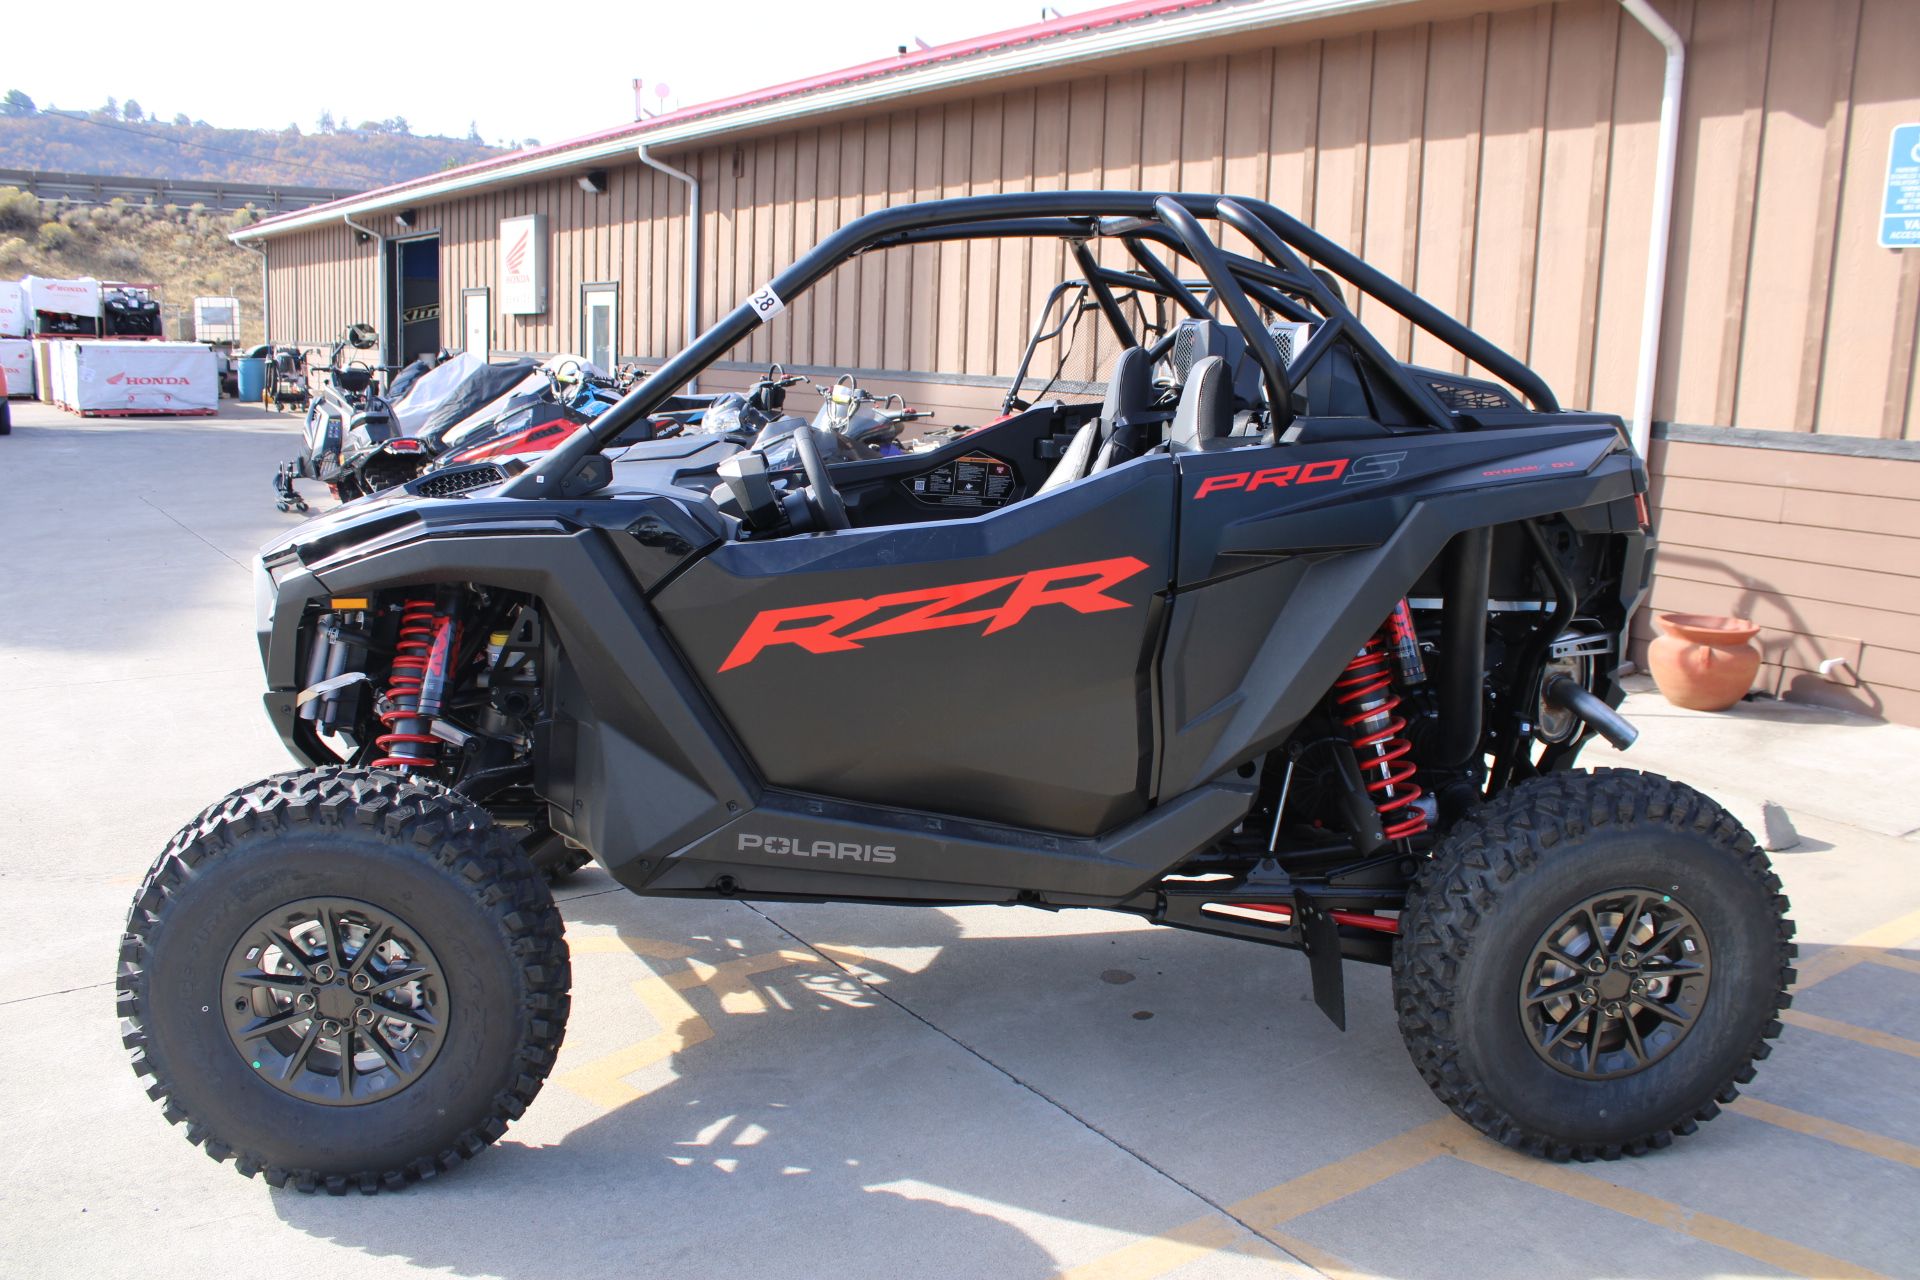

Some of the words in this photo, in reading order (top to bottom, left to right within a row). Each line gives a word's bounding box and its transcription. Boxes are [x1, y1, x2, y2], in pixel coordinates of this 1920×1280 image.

[754, 290, 775, 312] 28
[126, 376, 190, 385] HONDA
[1193, 458, 1350, 500] PRO
[1343, 451, 1408, 485] S
[717, 556, 1151, 674] RZR
[737, 833, 897, 864] POLARIS
